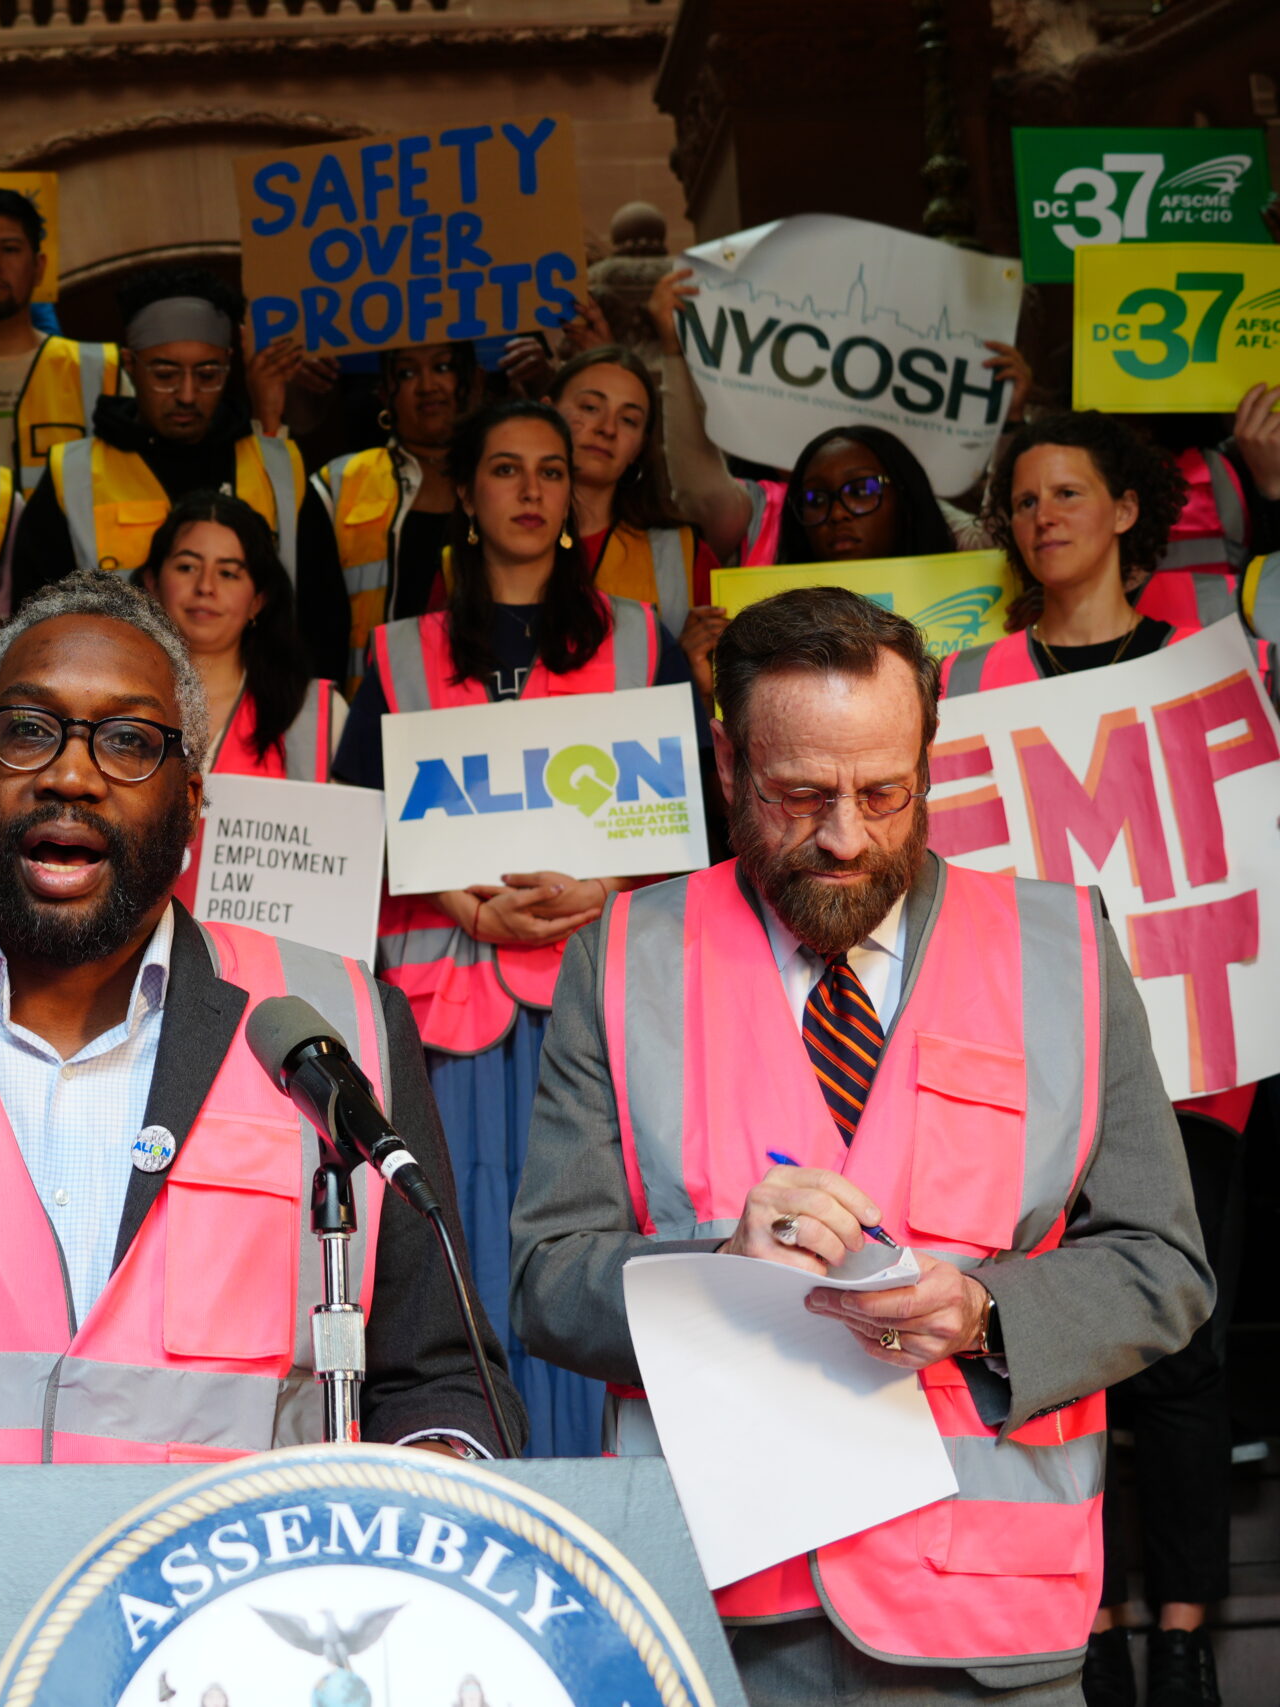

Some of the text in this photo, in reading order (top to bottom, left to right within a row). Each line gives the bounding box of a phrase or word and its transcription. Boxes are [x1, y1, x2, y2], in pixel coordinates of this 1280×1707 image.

[252, 117, 557, 236] SAFETY
[1033, 154, 1165, 250] DC 37
[1159, 194, 1231, 208] AFSCME
[309, 211, 493, 283] OVER
[251, 252, 577, 352] PROFITS
[1092, 272, 1245, 380] DC 37
[677, 299, 1007, 424] NYCOSH
[399, 736, 687, 821] ALIGN
[607, 801, 688, 818] ALLIANCE
[615, 813, 689, 828] GREATER
[217, 818, 313, 847] NATIONAL
[607, 824, 691, 840] NEW YORK
[213, 844, 348, 876] EMPLOYMENT
[210, 871, 254, 892] LAW
[207, 898, 293, 923] PROJECT
[133, 1141, 171, 1158] ALIGN
[118, 1502, 585, 1653] ASSEMBLY
